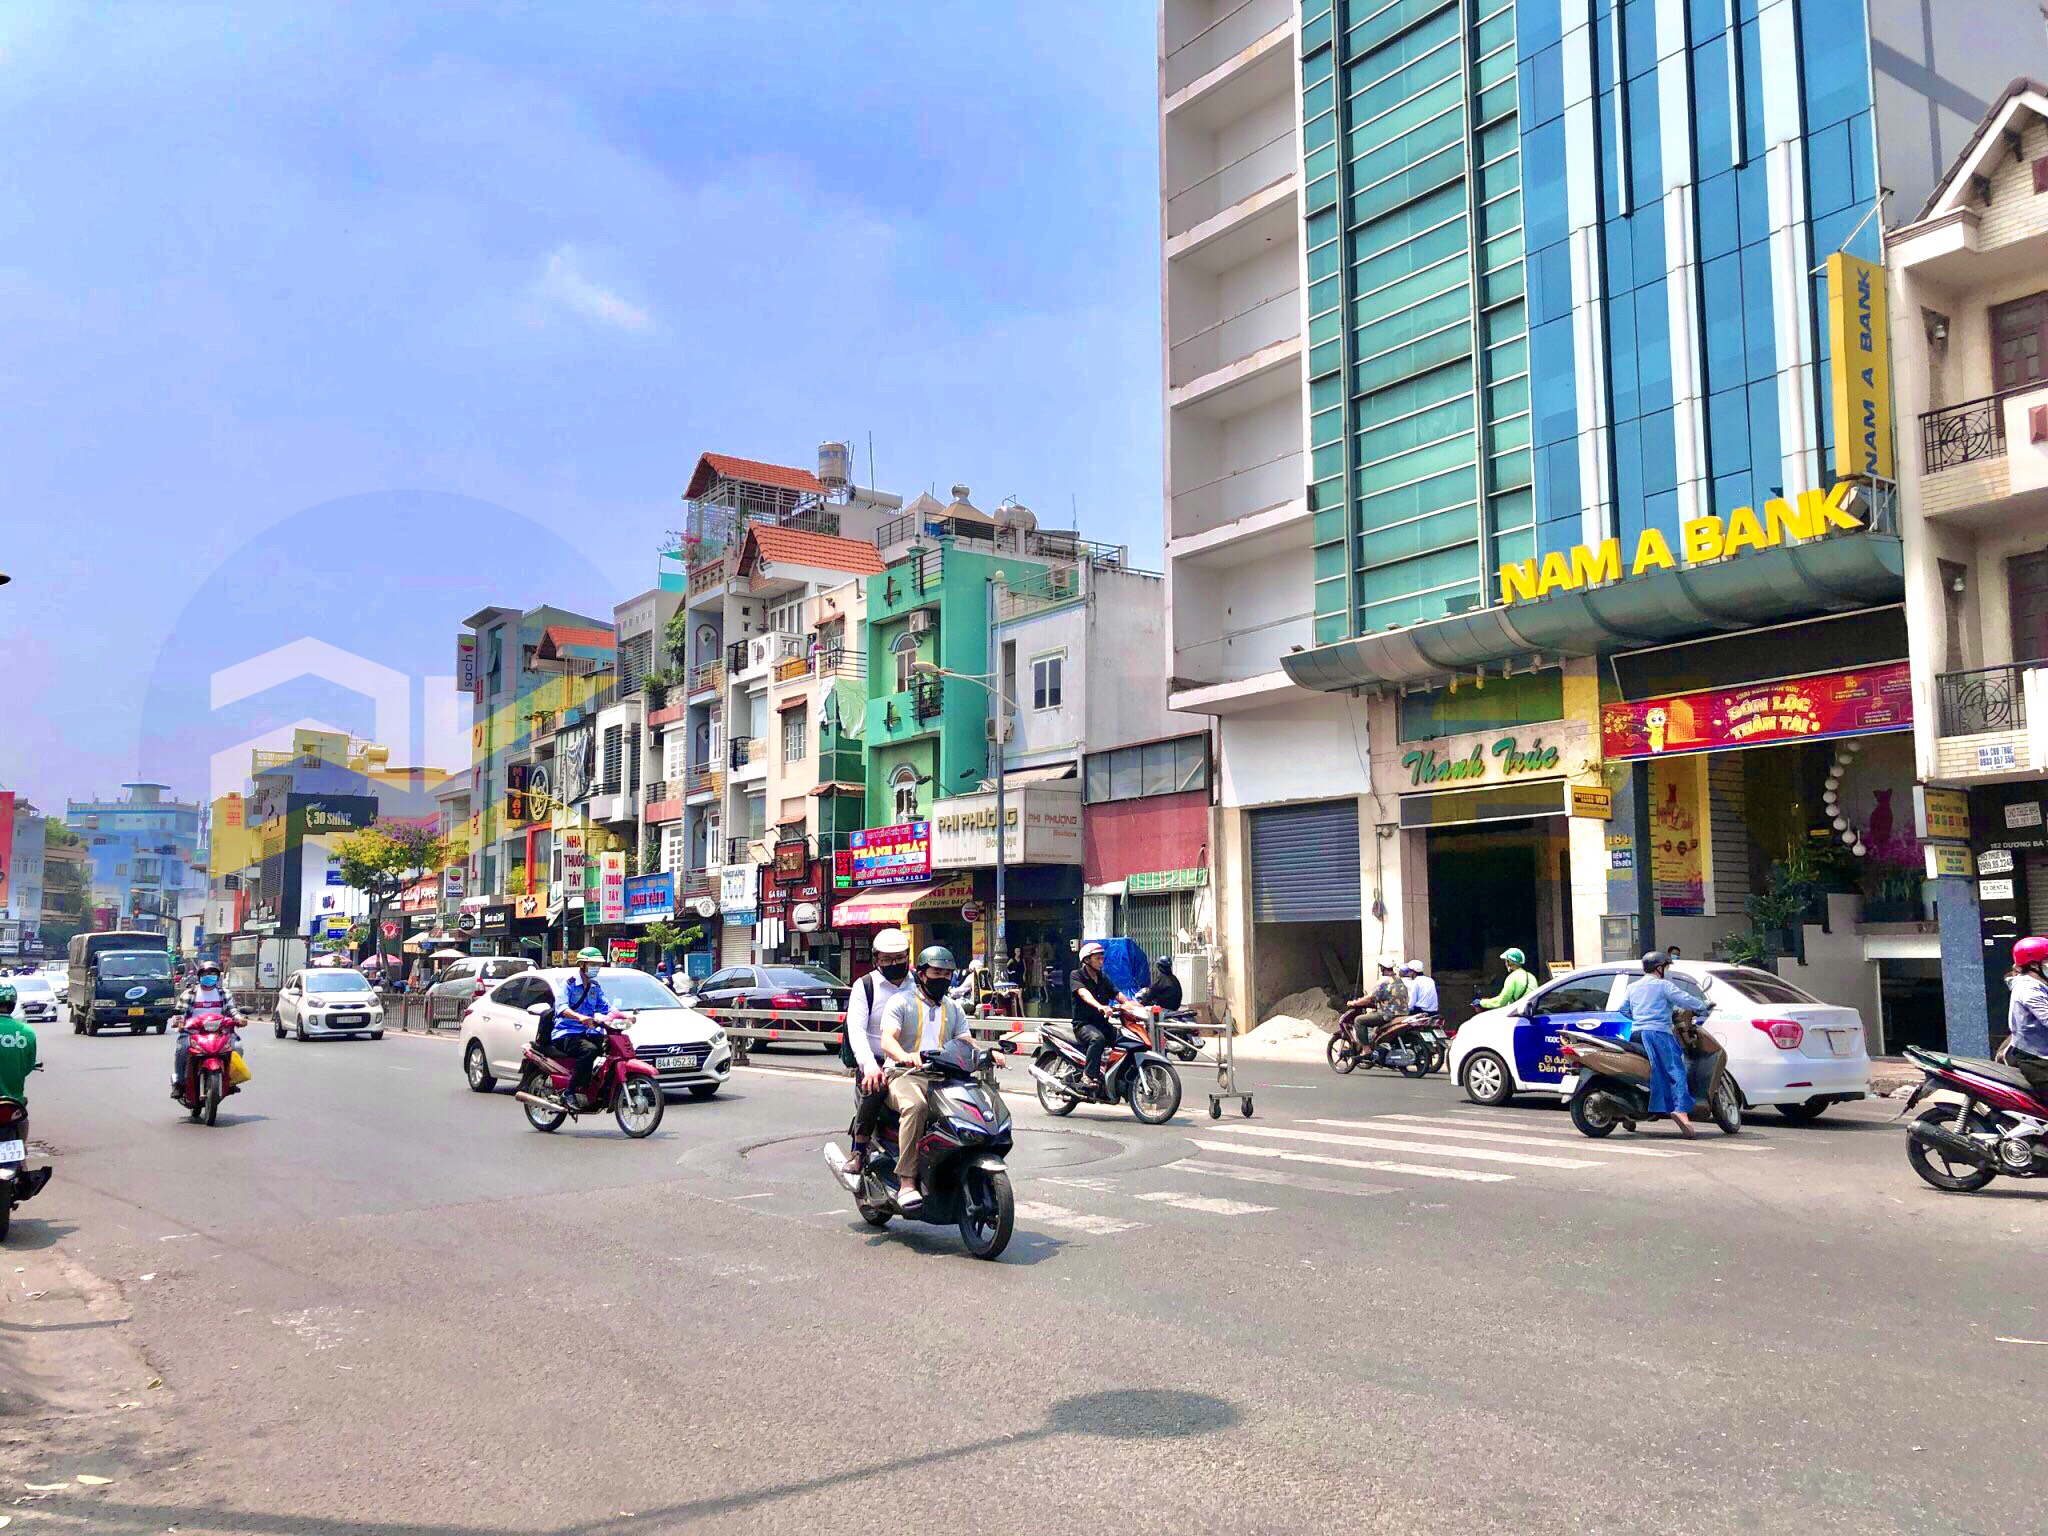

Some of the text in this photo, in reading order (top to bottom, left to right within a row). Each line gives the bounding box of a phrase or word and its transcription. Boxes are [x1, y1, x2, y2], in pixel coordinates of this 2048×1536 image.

[1857, 268, 1878, 476] NAM A BANK
[1499, 480, 1864, 606] NAM A BANK
[1772, 693, 1811, 712] LỘC
[1402, 736, 1559, 786] Thanh Trúc
[938, 814, 960, 832] PHI
[1028, 813, 1041, 824] PHI
[568, 871, 581, 887] TÂY
[802, 887, 818, 896] PIZZA
